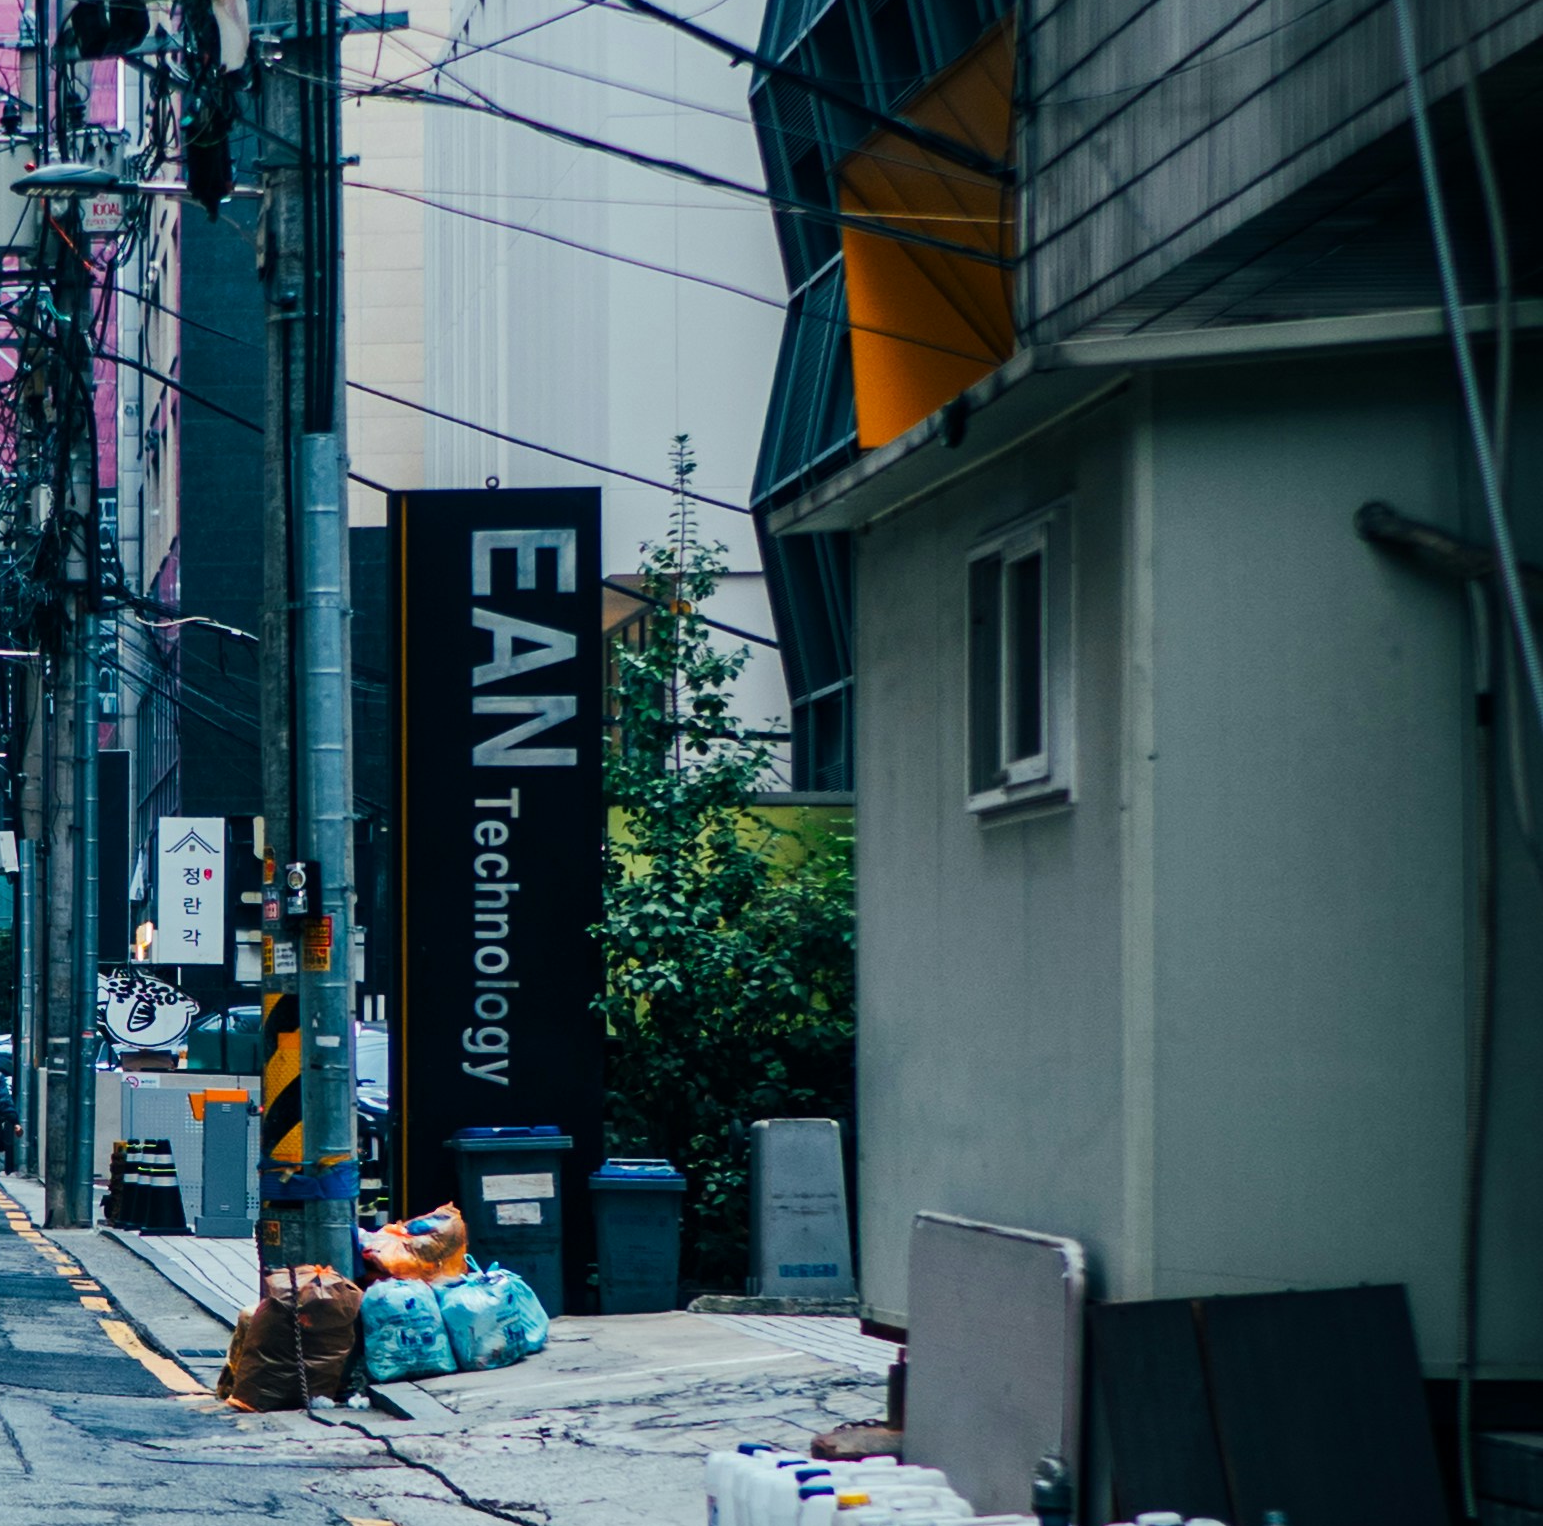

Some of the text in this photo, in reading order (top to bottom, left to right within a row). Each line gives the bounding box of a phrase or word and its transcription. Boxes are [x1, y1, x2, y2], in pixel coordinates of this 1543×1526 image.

[472, 529, 577, 766] EAN
[182, 867, 203, 947] 정란각
[462, 787, 520, 1087] Technology
